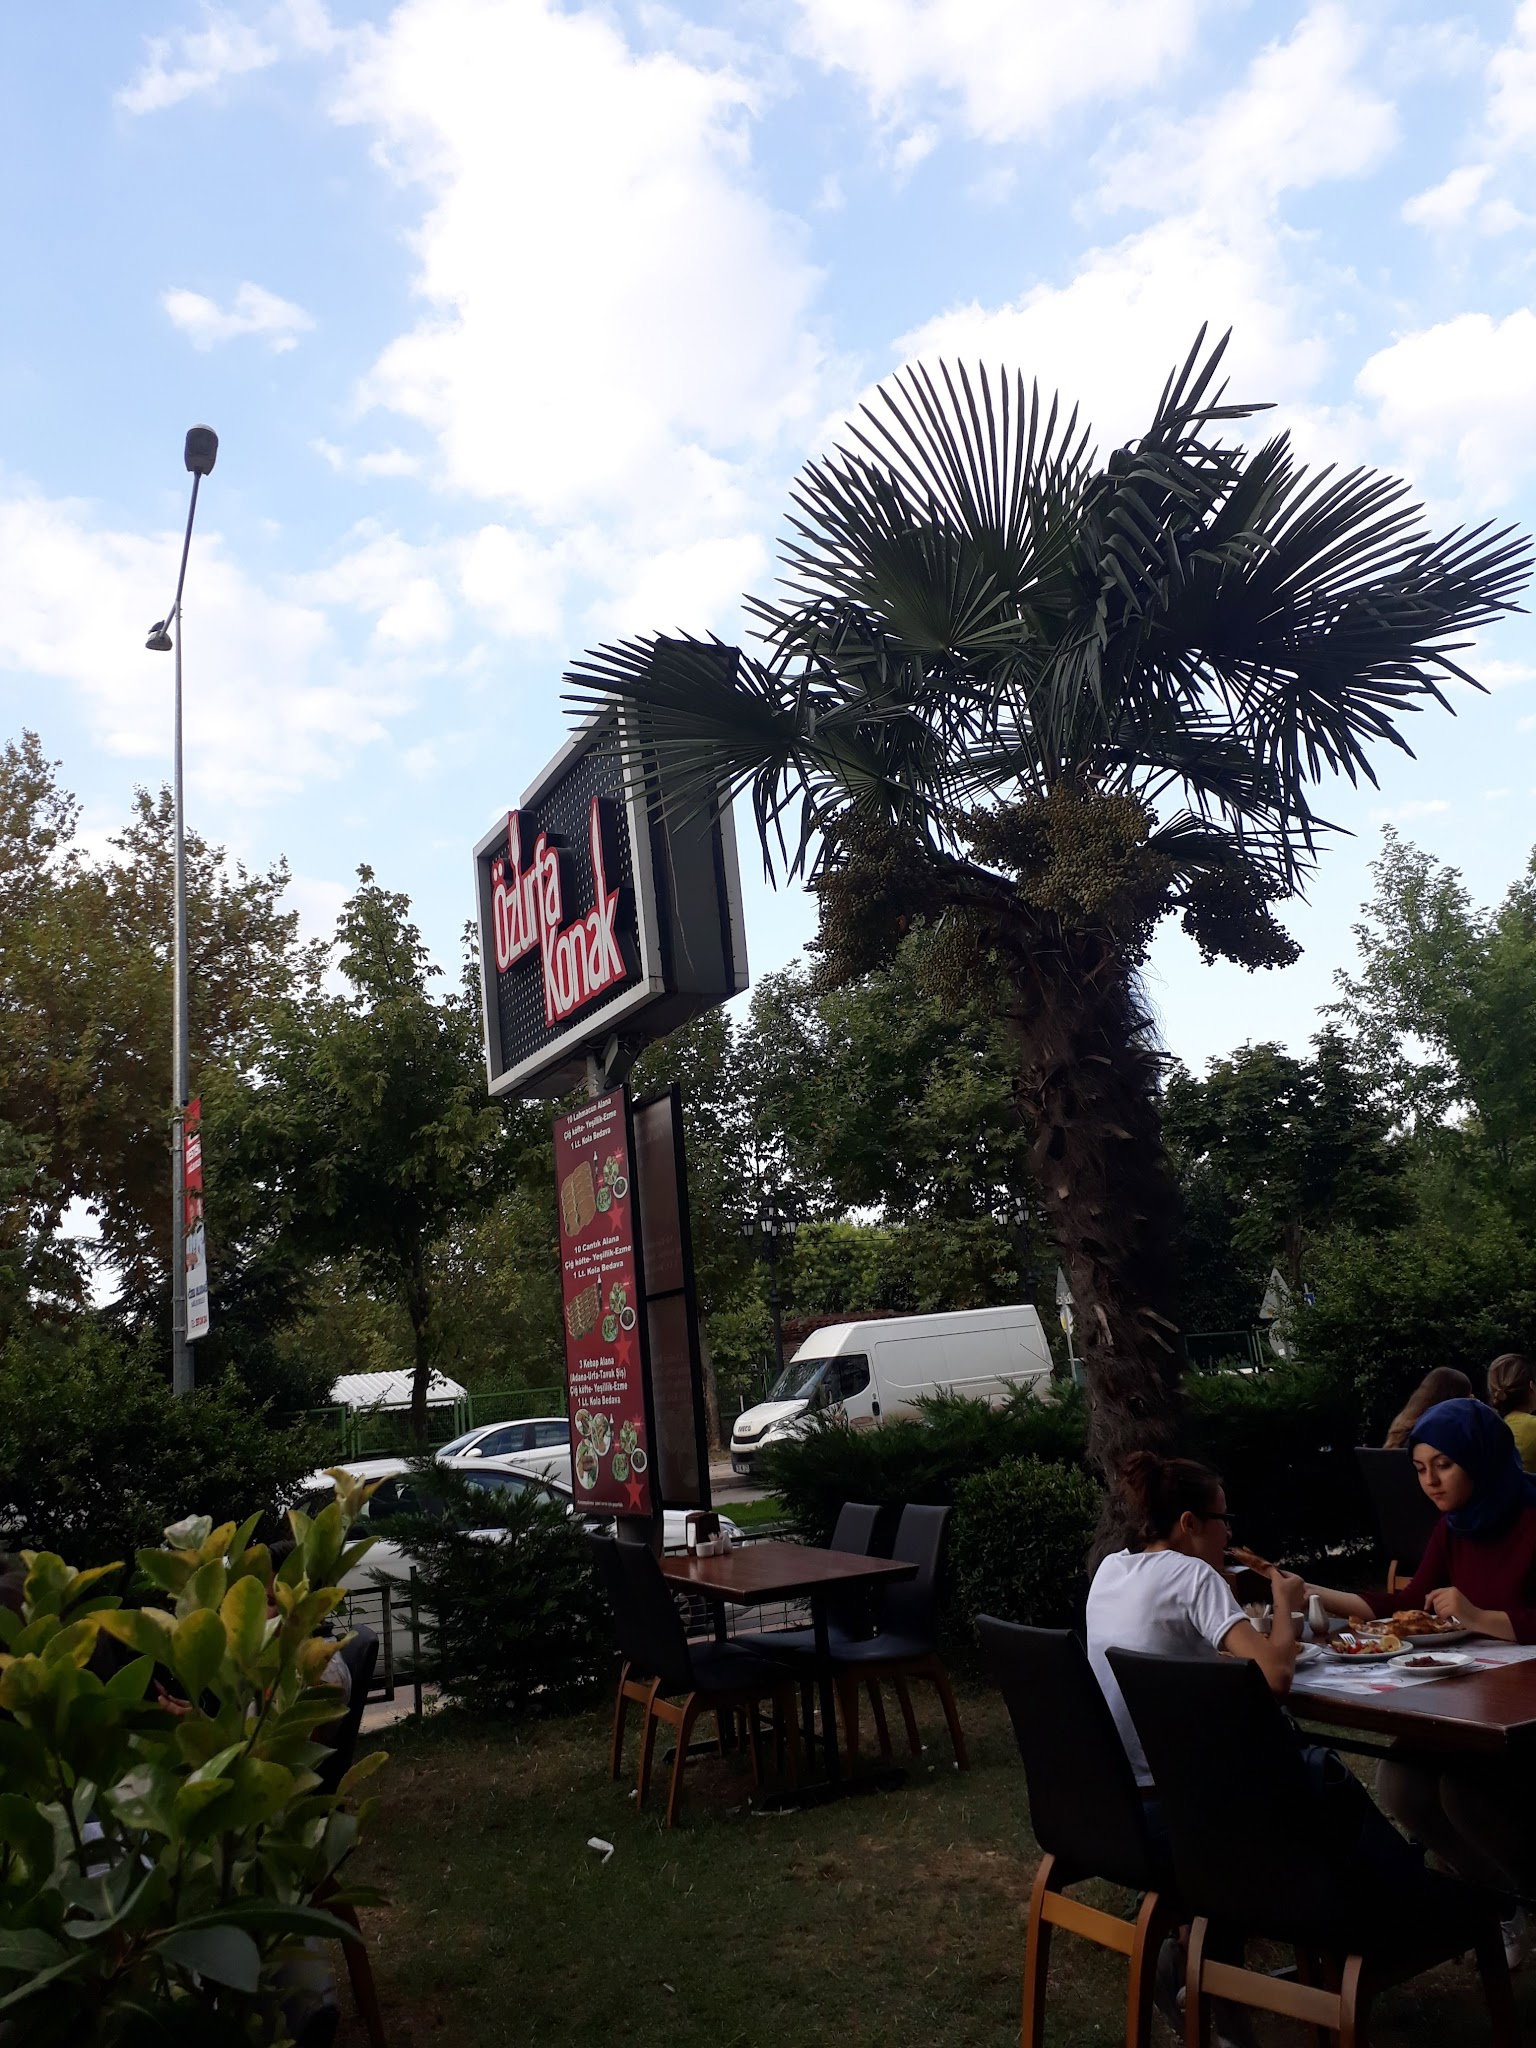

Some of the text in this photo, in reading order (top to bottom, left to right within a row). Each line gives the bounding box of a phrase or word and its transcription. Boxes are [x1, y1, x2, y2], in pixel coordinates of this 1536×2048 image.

[567, 1098, 612, 1124] 10 Lahmacun Alana
[581, 1133, 593, 1146] Kola
[593, 1127, 611, 1140] Bedava
[574, 1245, 581, 1254] 10
[602, 1235, 620, 1246] Alana
[564, 1260, 574, 1271] Çiğ
[592, 1245, 632, 1261] Yeşillik-Ezme
[577, 1269, 586, 1278] Lt.
[586, 1266, 601, 1276] Kola
[601, 1260, 624, 1272] Bedava
[583, 1358, 599, 1369] Kebap
[599, 1356, 615, 1366] Alana
[593, 1381, 628, 1394] Yeşillik-Ezme
[581, 1397, 589, 1406] Lt.
[589, 1396, 602, 1406] Kola
[601, 1395, 621, 1405] Bedava
